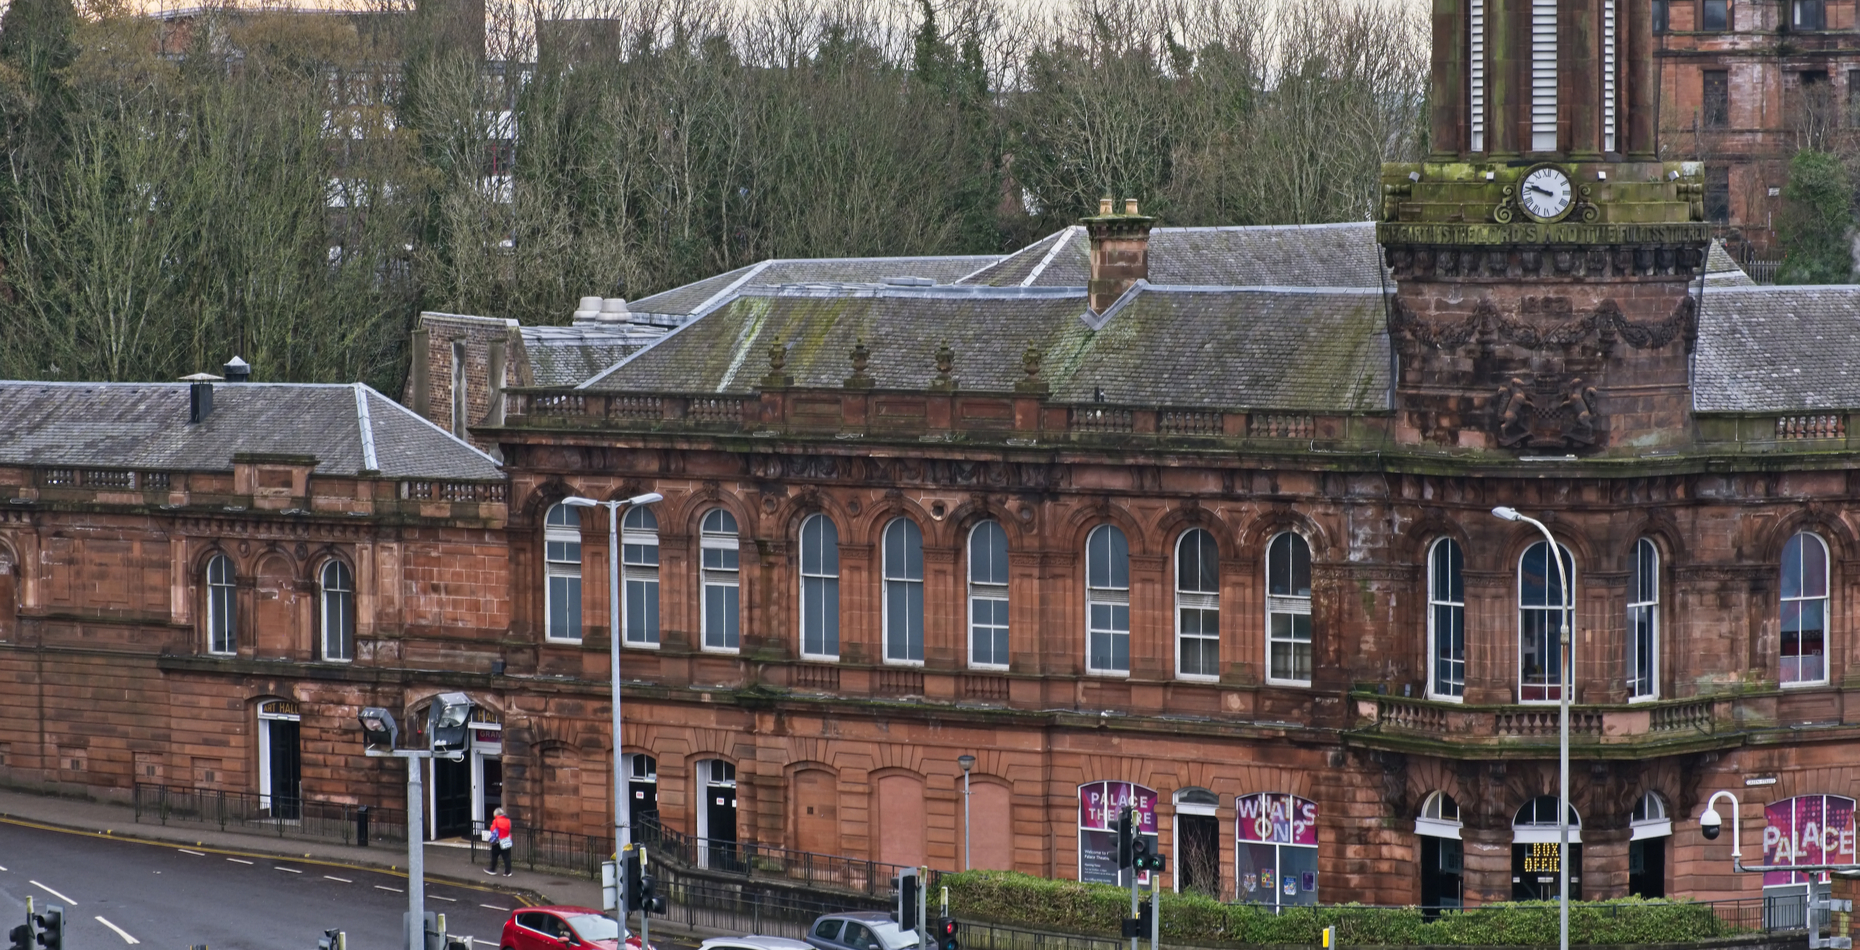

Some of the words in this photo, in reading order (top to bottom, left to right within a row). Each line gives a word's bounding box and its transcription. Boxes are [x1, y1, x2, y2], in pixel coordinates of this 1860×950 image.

[1400, 225, 1435, 243] EARTH
[1453, 226, 1475, 243] THE
[1539, 226, 1578, 243] AND
[264, 702, 276, 713] ART
[280, 702, 299, 715] HALL
[480, 731, 501, 739] GRAN
[1091, 792, 1148, 809] PALACE
[1089, 808, 1151, 824] THERE
[1239, 795, 1315, 826] WHAT'S
[1533, 842, 1558, 857] BOX
[1764, 822, 1853, 862] PALACE
[1525, 858, 1560, 873] OFFIC
